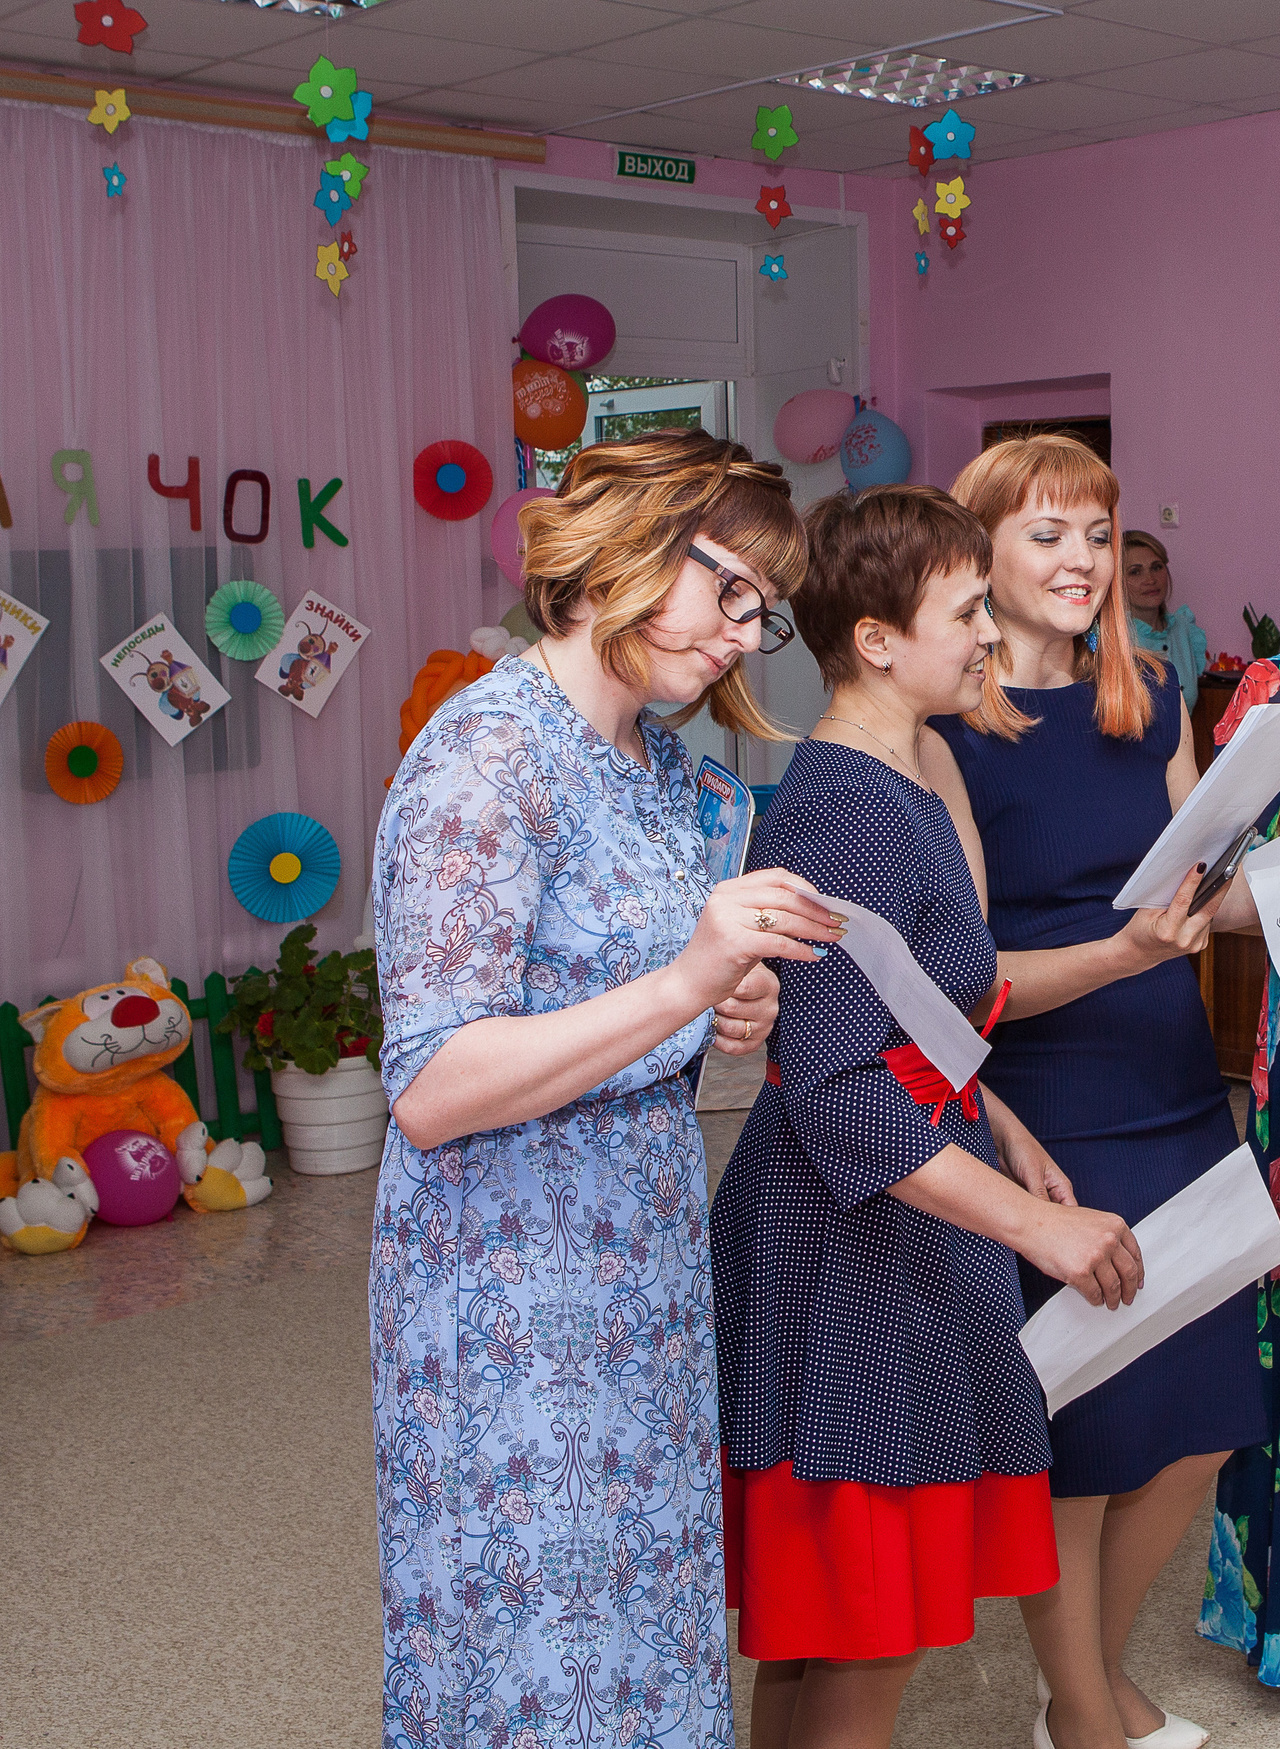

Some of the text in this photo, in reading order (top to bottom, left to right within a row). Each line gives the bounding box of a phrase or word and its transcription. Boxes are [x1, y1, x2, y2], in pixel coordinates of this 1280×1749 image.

[624, 155, 689, 181] ВЫХОД
[0, 449, 349, 549] ЯЧОК
[0, 597, 41, 635] ЧИКИ
[304, 600, 362, 643] ЗНАЙКИ
[111, 623, 165, 668] НЕПОСЕДЫ
